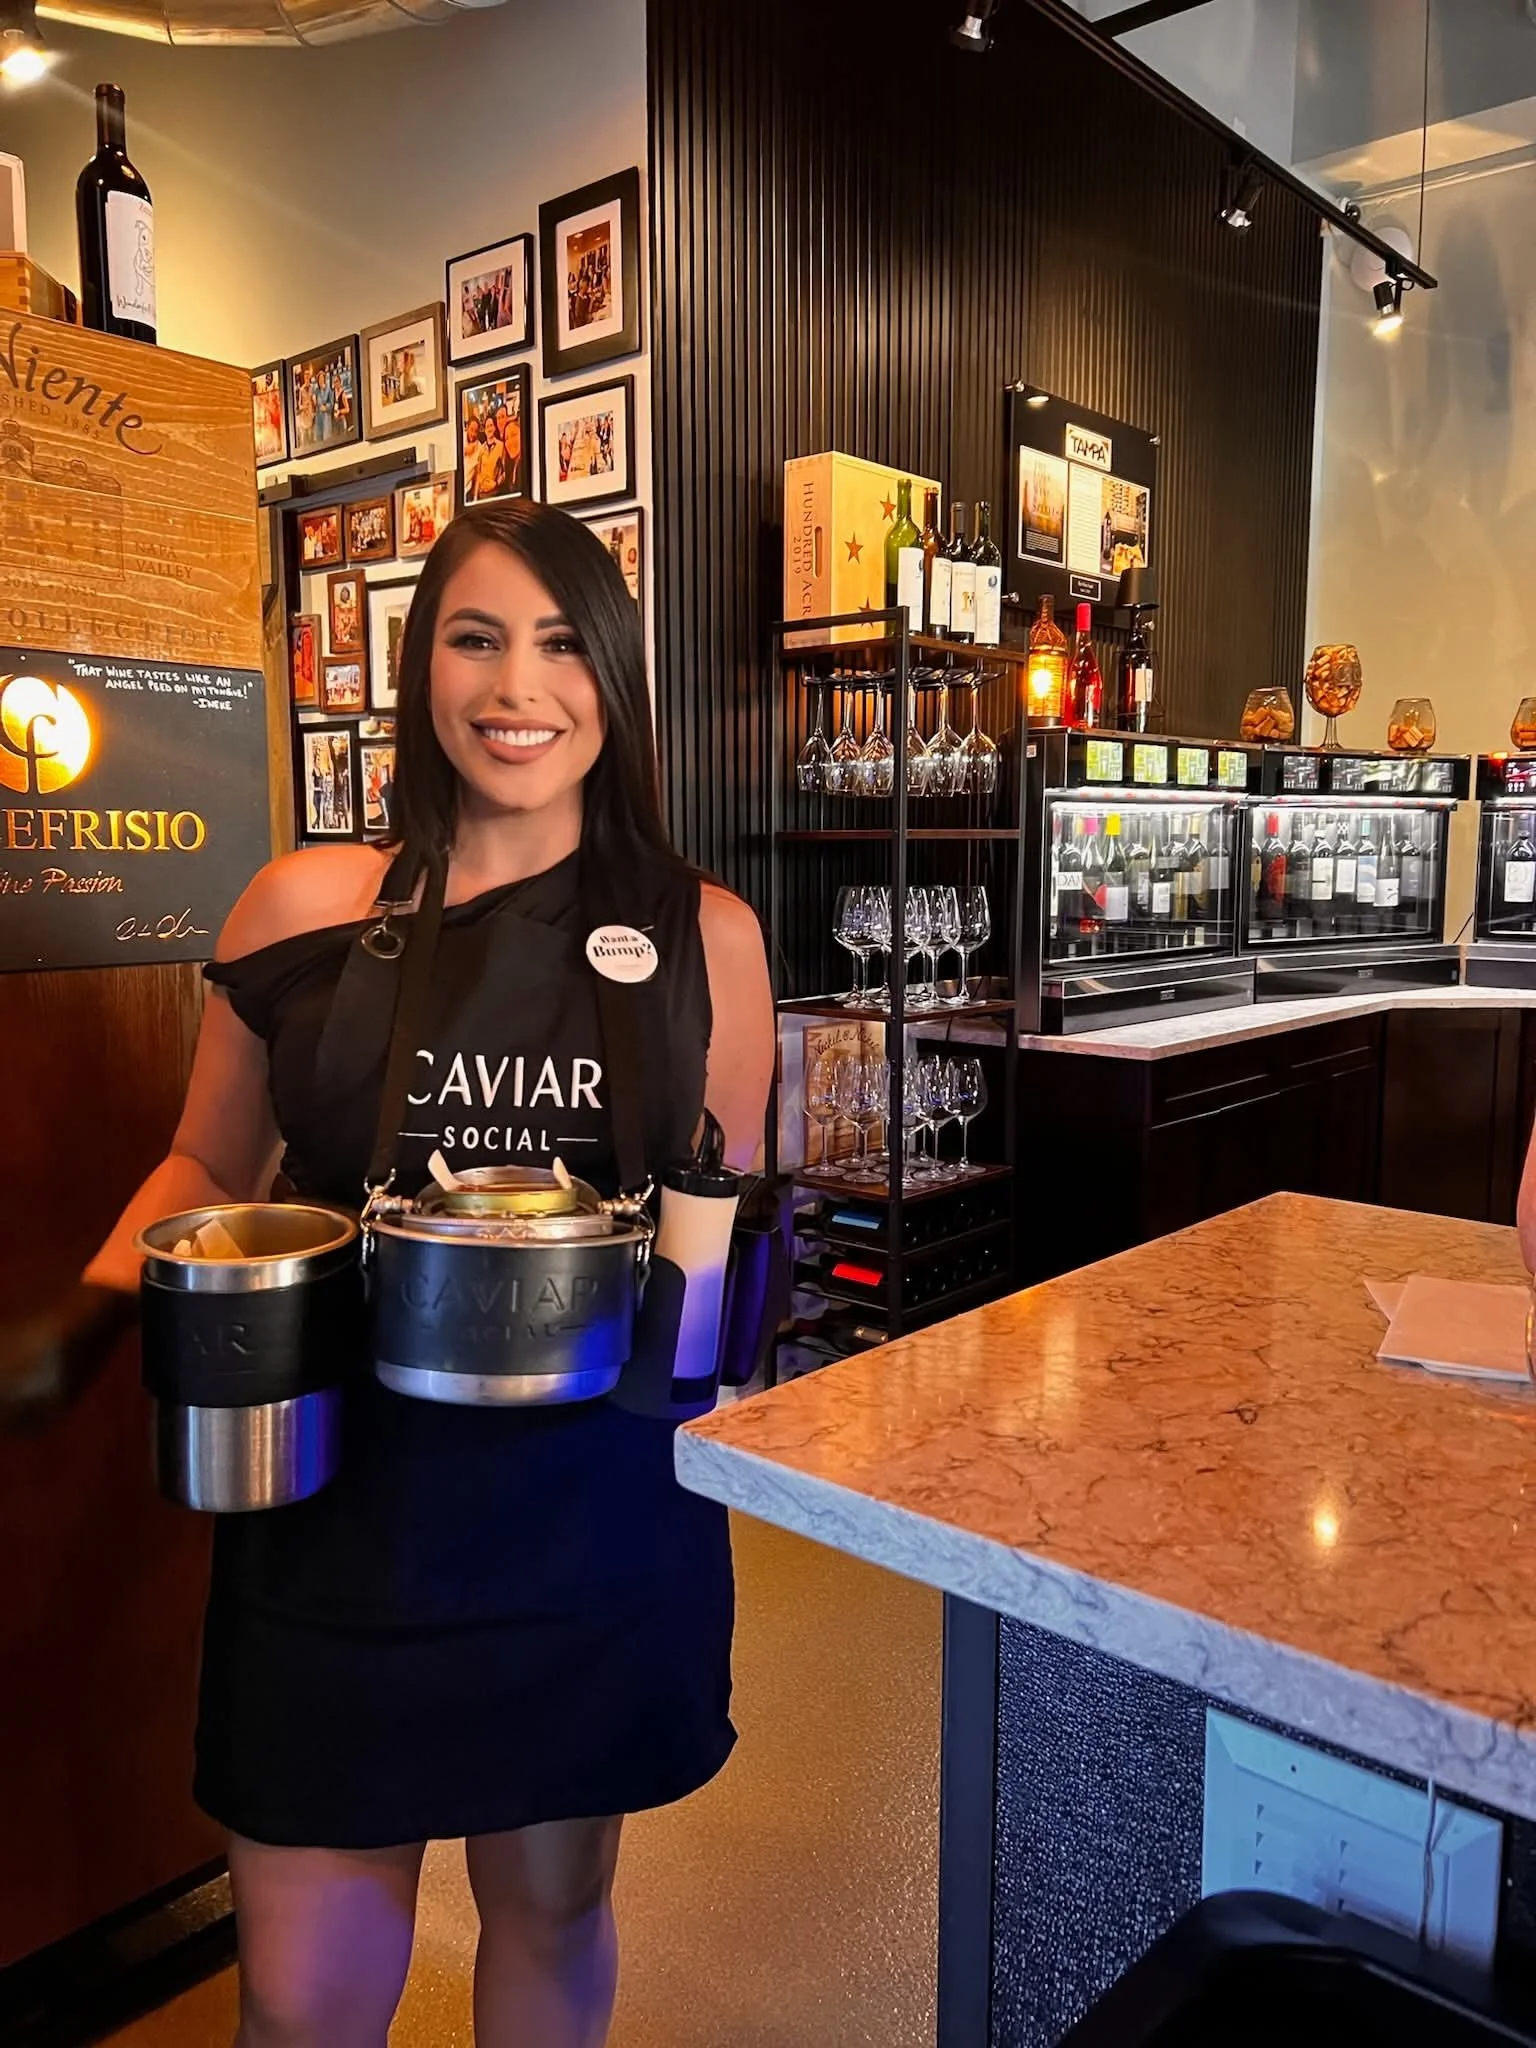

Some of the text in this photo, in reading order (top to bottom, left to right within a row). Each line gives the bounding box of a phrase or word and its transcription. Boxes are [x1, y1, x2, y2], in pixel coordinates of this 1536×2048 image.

[0, 322, 162, 455] Niente
[1070, 435, 1106, 464] TAMPA
[803, 481, 814, 573] HUNDRED
[134, 541, 177, 559] NAPA
[793, 536, 802, 575] 2019
[136, 559, 193, 579] VALLEY
[105, 665, 134, 679] WINE
[136, 669, 180, 682] TASTES
[184, 672, 212, 685] LIKE
[216, 676, 231, 688] AN
[105, 679, 144, 691] ANGEL
[148, 680, 173, 693] PEED
[174, 683, 188, 693] ON
[191, 685, 206, 697] MY
[1, 808, 207, 851] EFRISIO
[0, 867, 124, 895] ine Passion
[593, 943, 651, 958] Bump?
[407, 1049, 603, 1109] CAVIAR
[442, 1126, 551, 1151] SOCIAL
